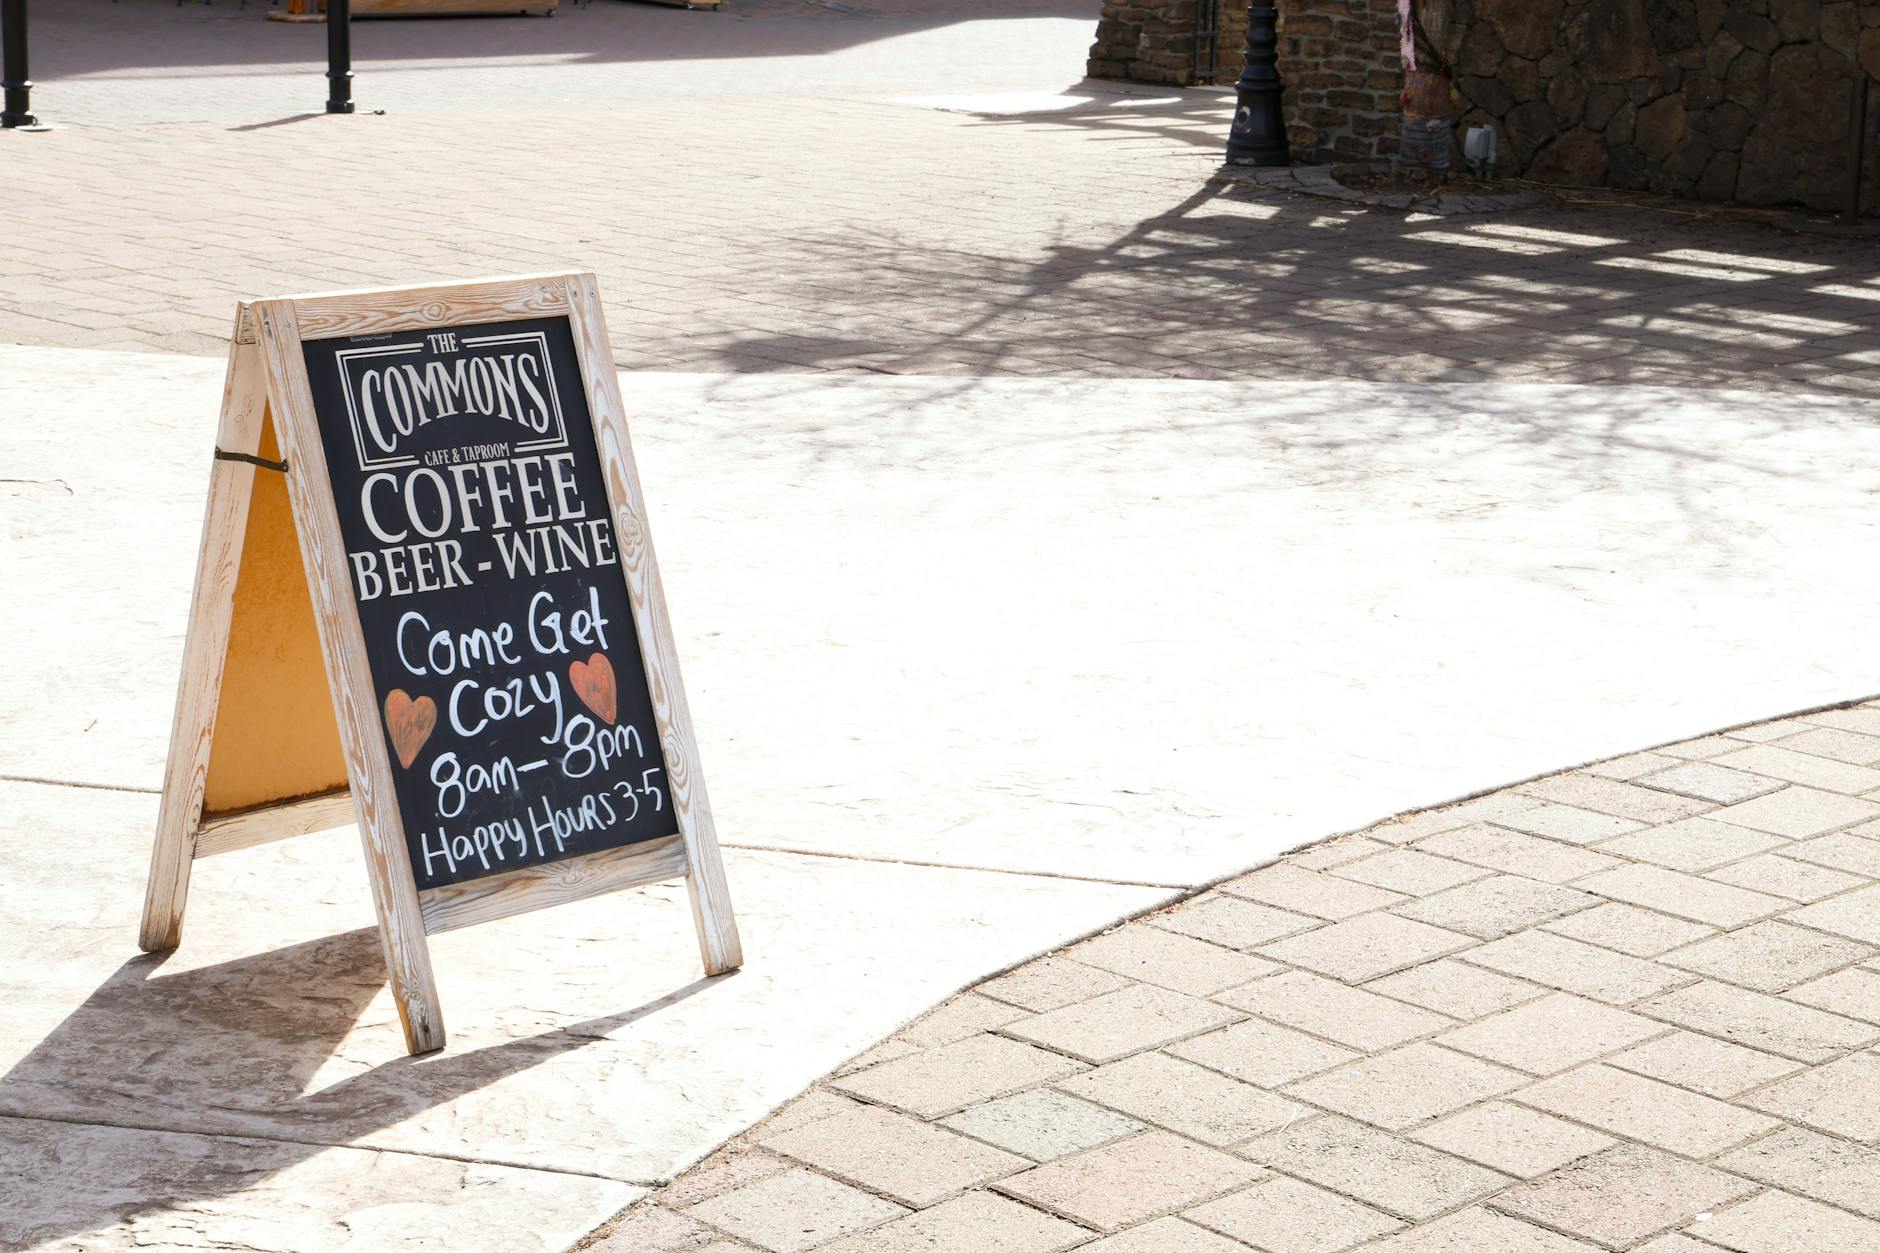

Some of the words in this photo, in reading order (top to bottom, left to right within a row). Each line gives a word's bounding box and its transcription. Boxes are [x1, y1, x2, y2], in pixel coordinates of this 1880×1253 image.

[426, 332, 459, 354] THE
[361, 353, 549, 453] COMMONS
[361, 452, 585, 544] COFFEE
[424, 449, 451, 466] CAFE
[451, 447, 461, 463] &
[461, 442, 510, 461] TAPROOM
[396, 611, 521, 676] Come
[528, 586, 609, 654] Get
[449, 671, 563, 745] Cozy
[421, 817, 528, 877] Happy
[613, 767, 663, 822] 3-5
